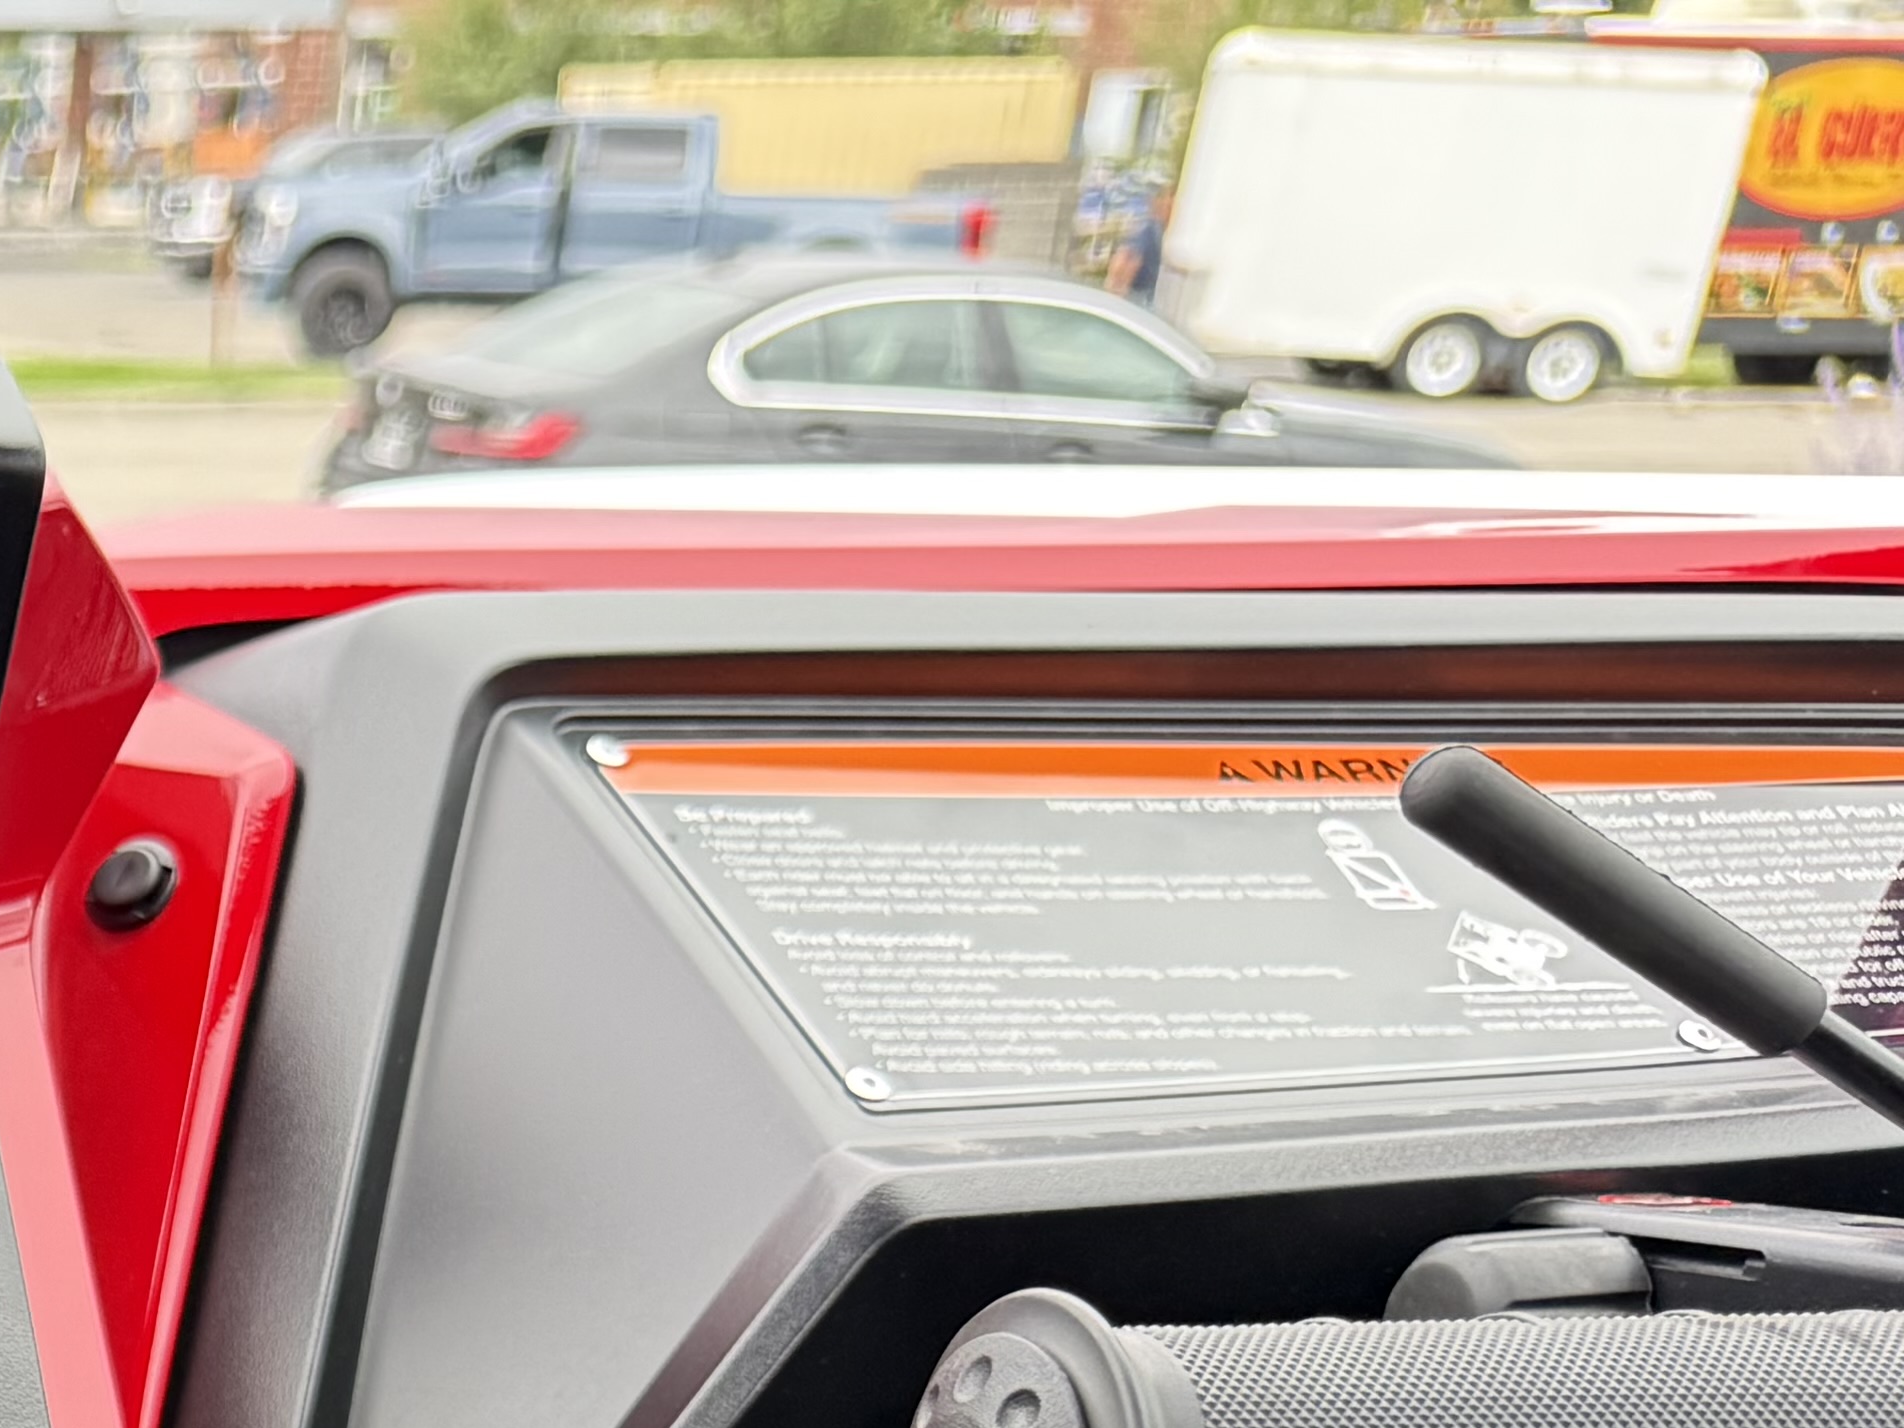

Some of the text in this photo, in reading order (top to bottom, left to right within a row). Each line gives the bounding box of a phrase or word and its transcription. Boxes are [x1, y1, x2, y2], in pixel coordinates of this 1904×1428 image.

[1251, 758, 1412, 783] WARN
[1699, 808, 1792, 825] Attention
[1785, 869, 1835, 884] Your
